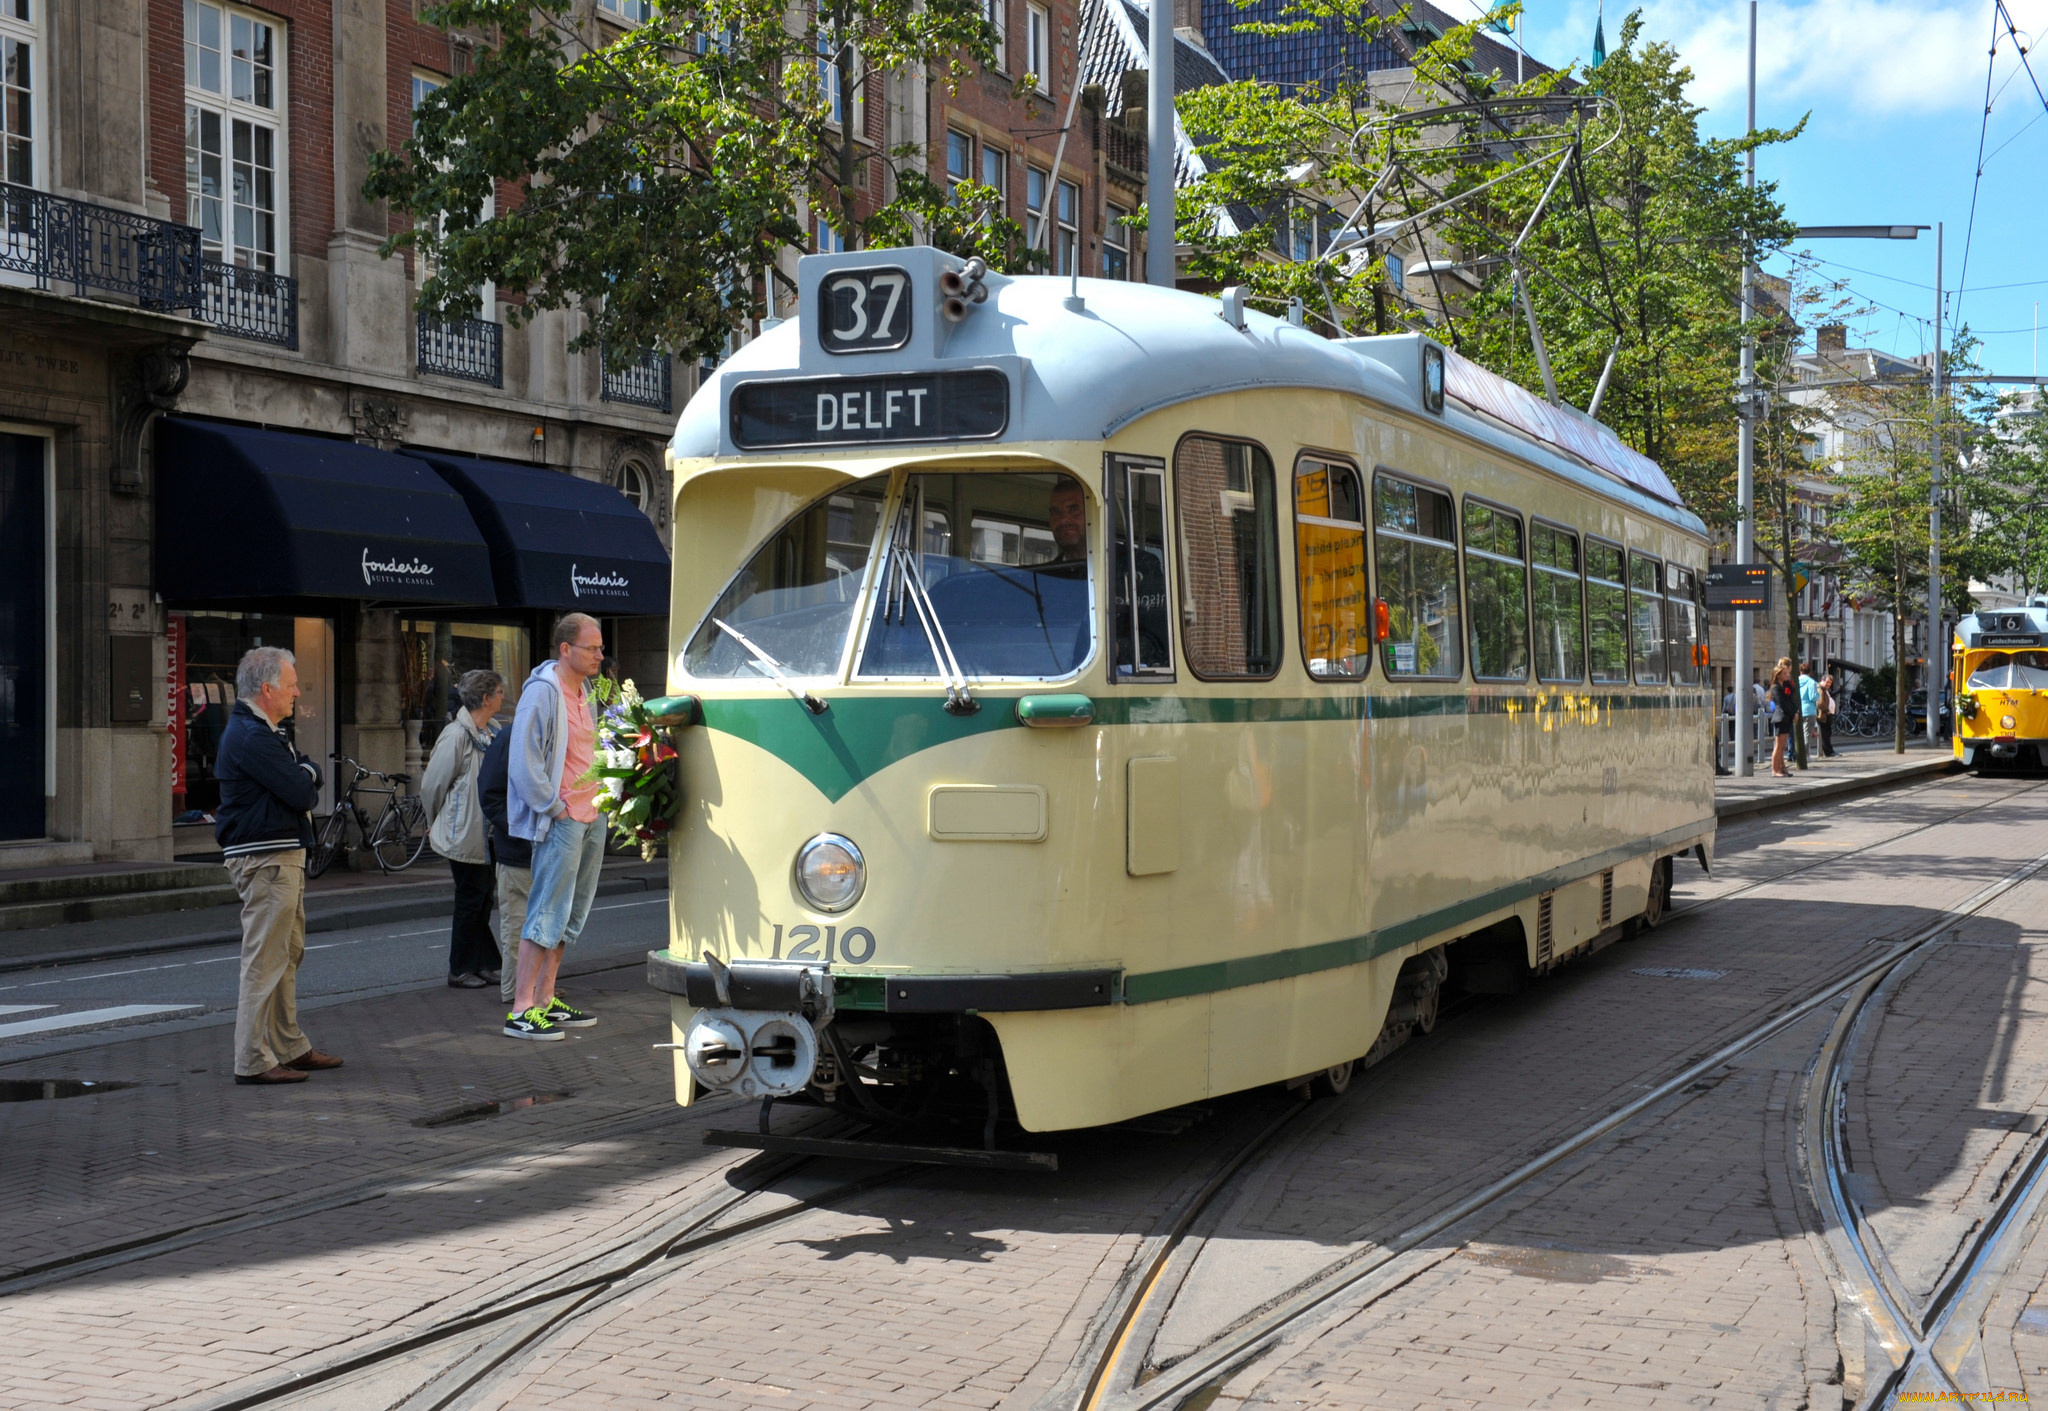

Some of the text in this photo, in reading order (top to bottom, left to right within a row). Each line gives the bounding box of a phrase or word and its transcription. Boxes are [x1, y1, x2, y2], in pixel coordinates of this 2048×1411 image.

[831, 274, 905, 341] 37
[35, 355, 79, 374] TWEE
[816, 388, 928, 431] DELFT
[361, 547, 434, 587] fonderie
[371, 575, 395, 584] SUITS
[405, 578, 435, 586] CASUAL
[571, 563, 629, 598] fonderie
[1987, 637, 2034, 645] Leidschendam
[2006, 617, 2016, 630] 6
[768, 924, 877, 965] 1210
